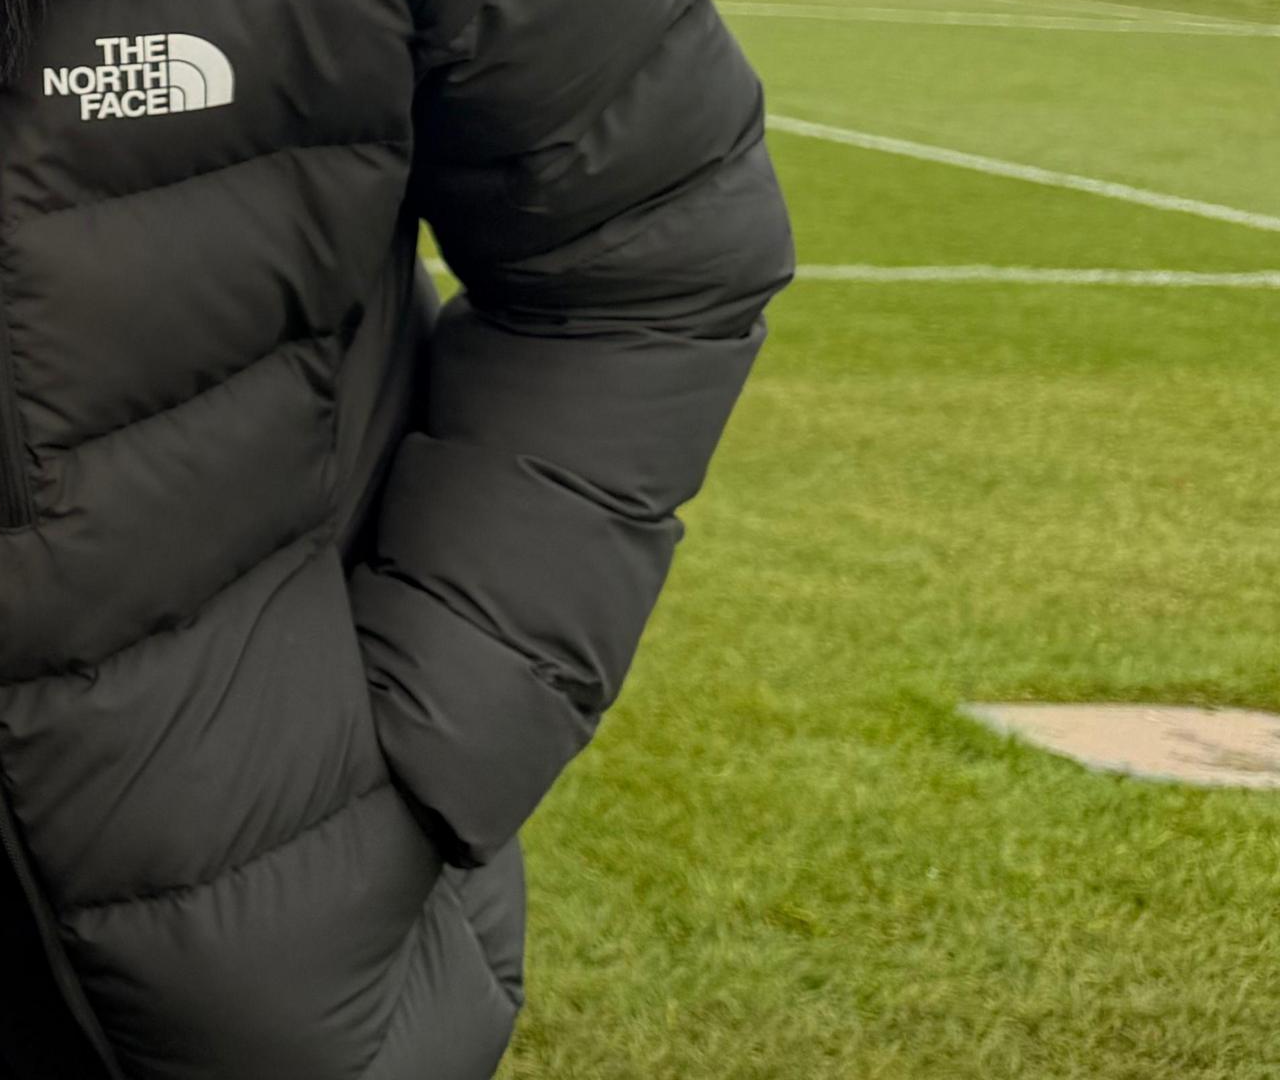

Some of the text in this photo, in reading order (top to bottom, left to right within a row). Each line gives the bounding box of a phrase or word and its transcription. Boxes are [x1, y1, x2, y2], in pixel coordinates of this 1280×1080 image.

[95, 34, 167, 65] THE
[43, 62, 168, 96] NORTH
[80, 88, 169, 121] FACE
